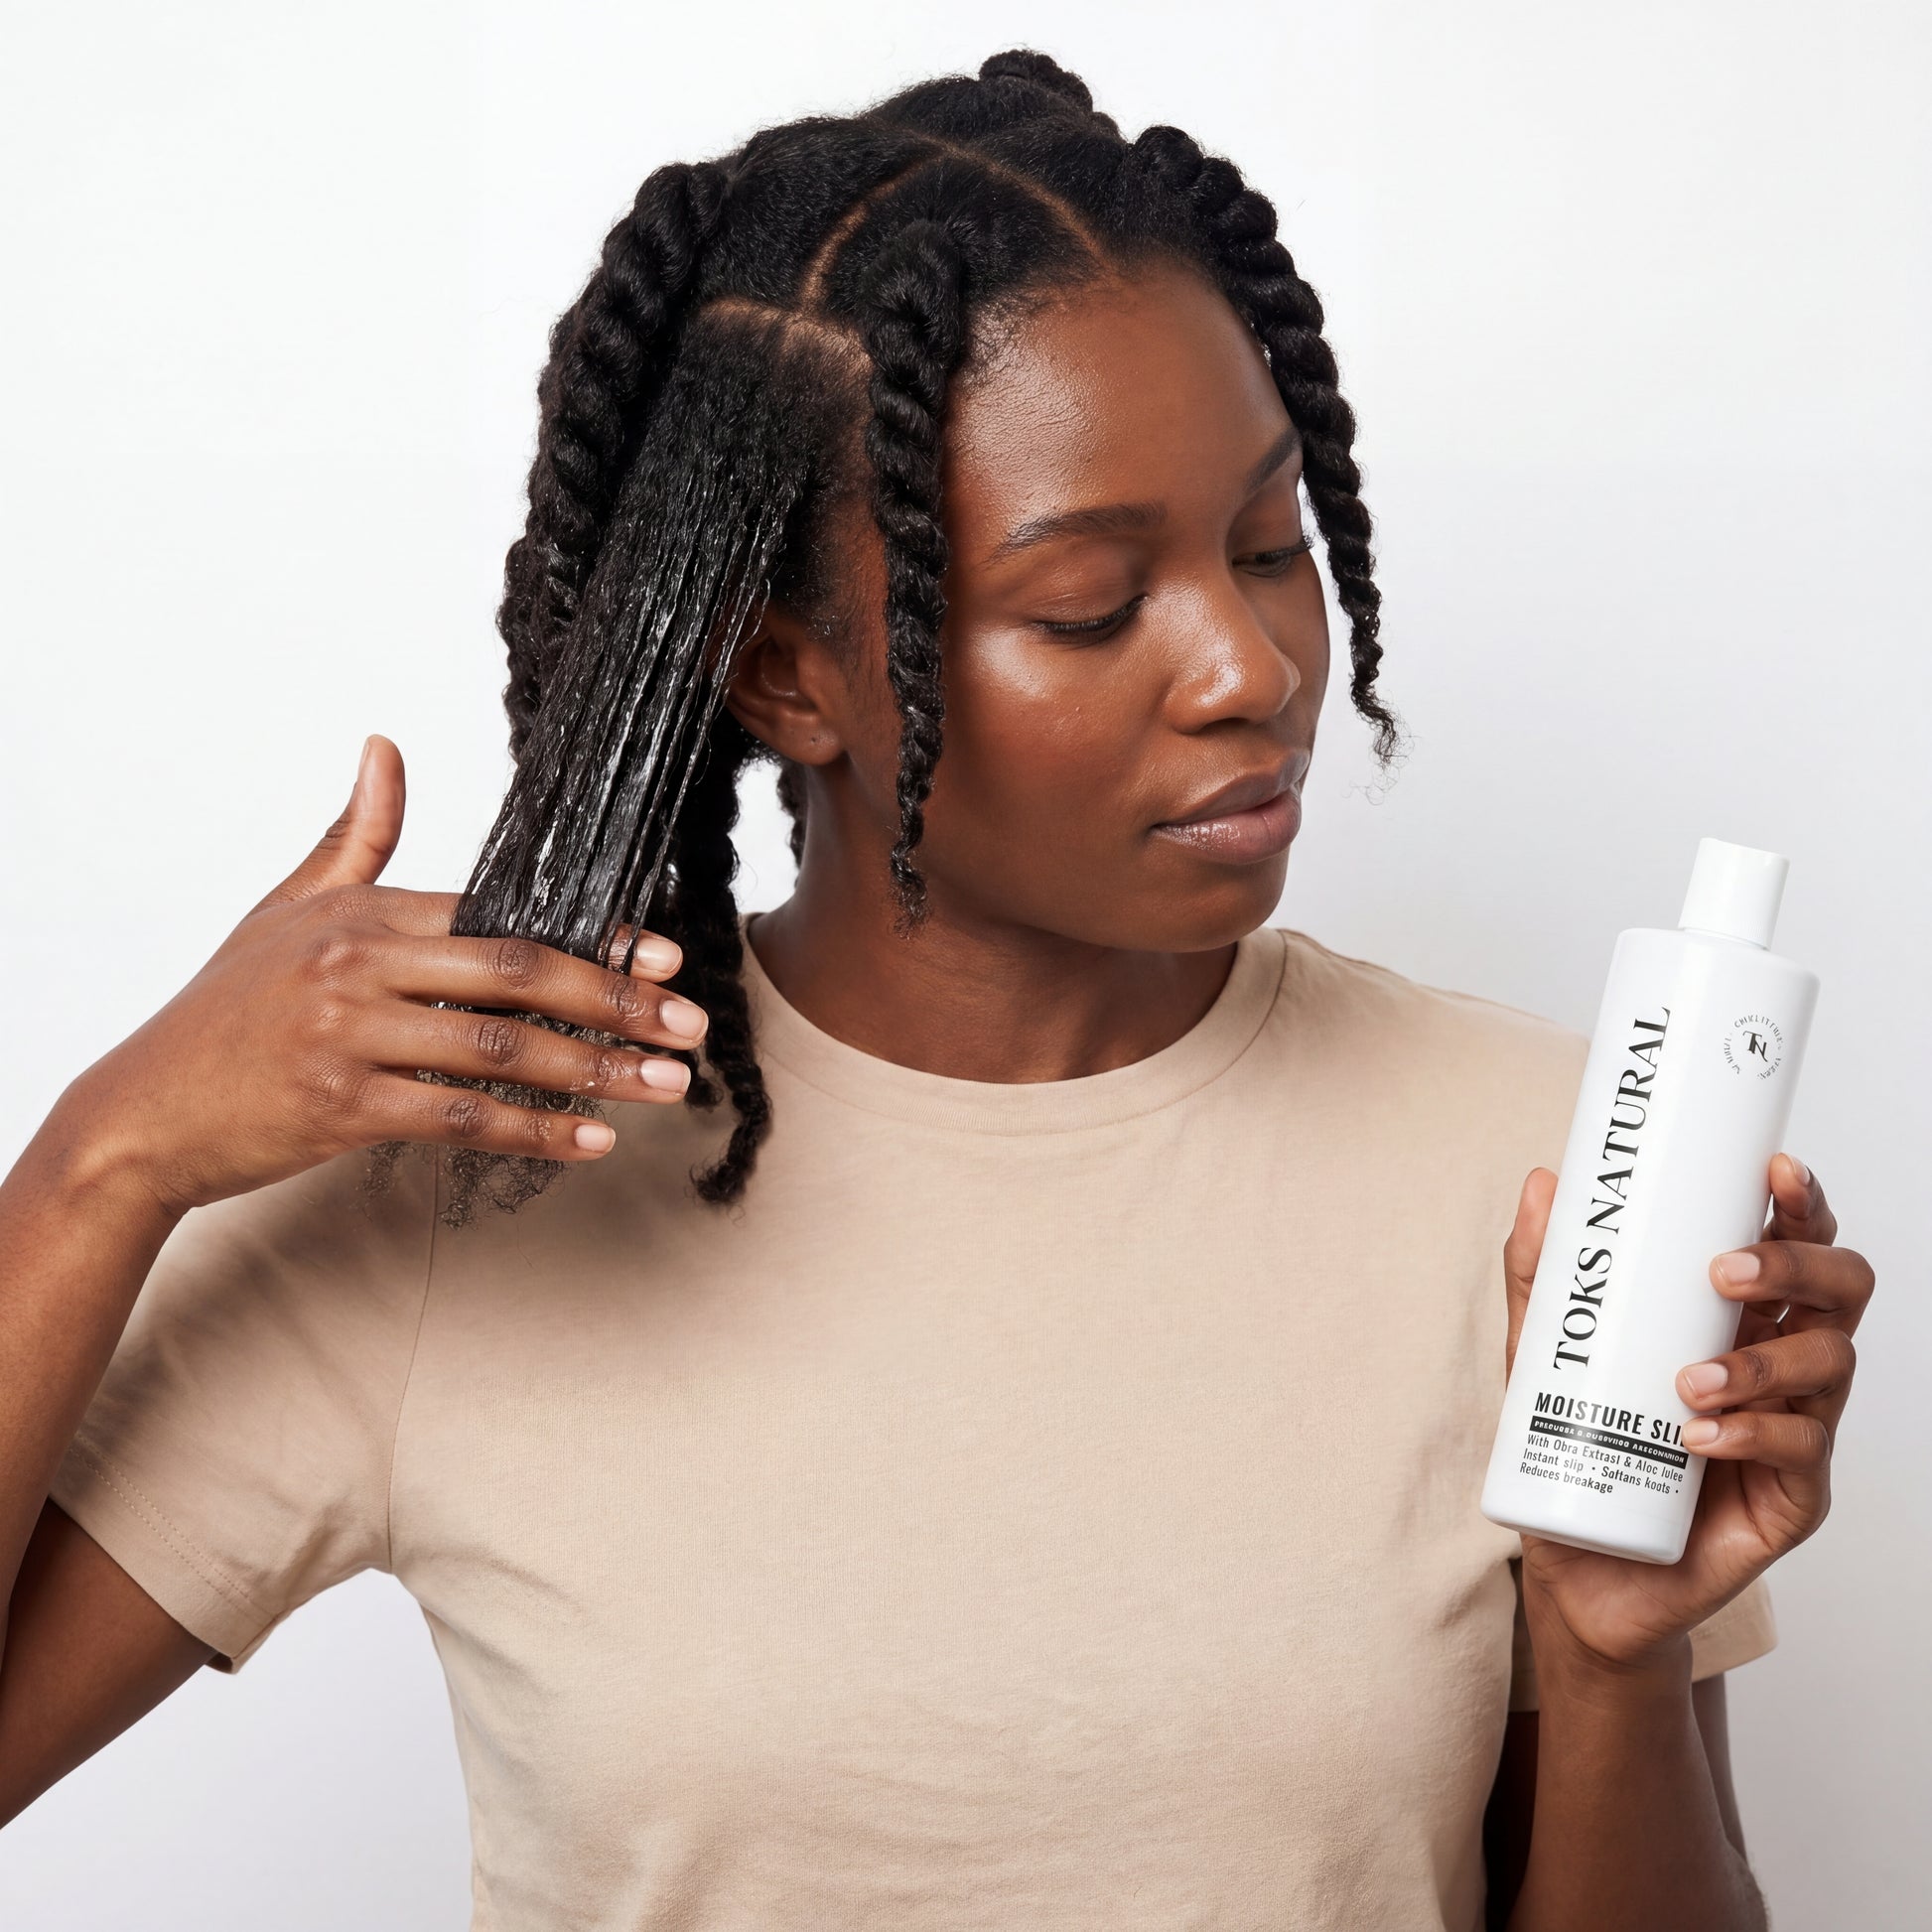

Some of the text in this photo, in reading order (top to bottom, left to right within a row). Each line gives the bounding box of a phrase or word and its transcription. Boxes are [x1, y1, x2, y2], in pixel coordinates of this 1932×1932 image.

[1553, 1247, 1612, 1370] TOKS
[1586, 1007, 1671, 1234] NATURAL
[1534, 1392, 1645, 1435] MOISTURE
[1650, 1419, 1685, 1448] SLI
[1523, 1448, 1559, 1466] Instant
[1563, 1458, 1585, 1473] slip
[1527, 1434, 1550, 1449] With
[1623, 1455, 1632, 1468] &
[1519, 1461, 1613, 1494] Reduces breakage
